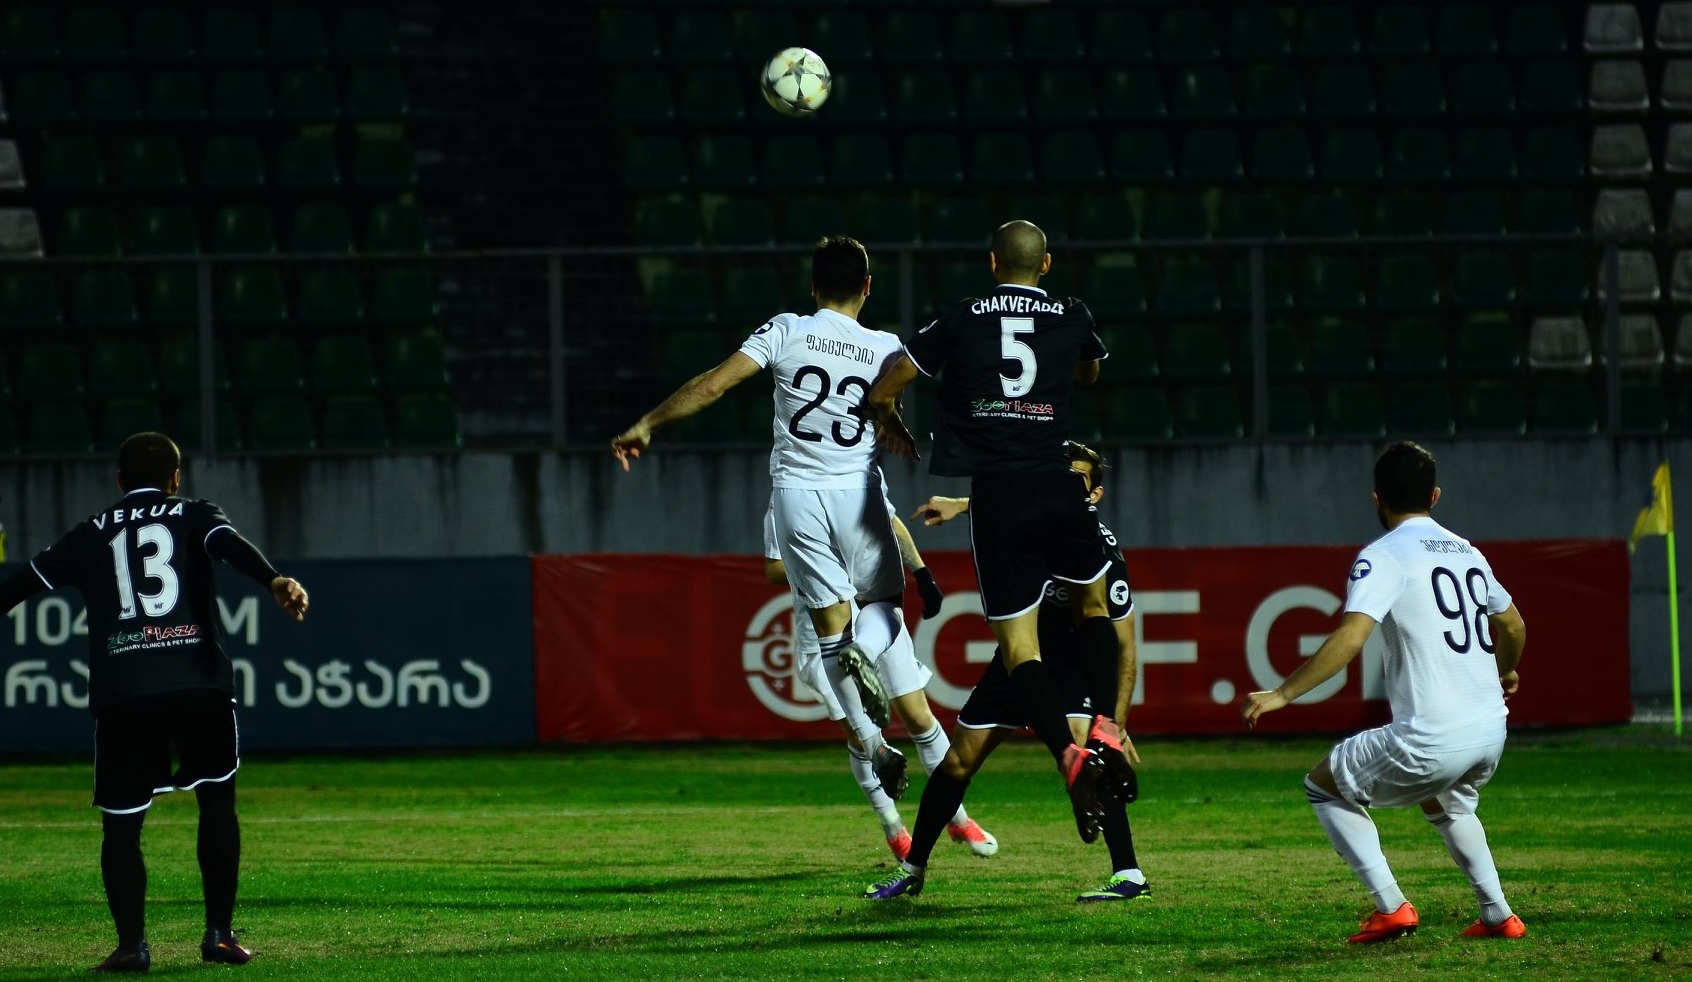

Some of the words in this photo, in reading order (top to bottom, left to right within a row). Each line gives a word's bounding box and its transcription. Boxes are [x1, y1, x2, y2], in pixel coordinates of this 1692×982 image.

[971, 295, 1064, 315] CHAKVETADZE
[806, 333, 875, 365] ფანცულაია
[999, 317, 1038, 398] 5
[788, 365, 872, 448] 23
[92, 502, 184, 531] VEKUA
[108, 523, 179, 620] 13
[1431, 566, 1496, 654] 98
[141, 641, 166, 650] CLINICS
[274, 657, 493, 709] აჭარა
